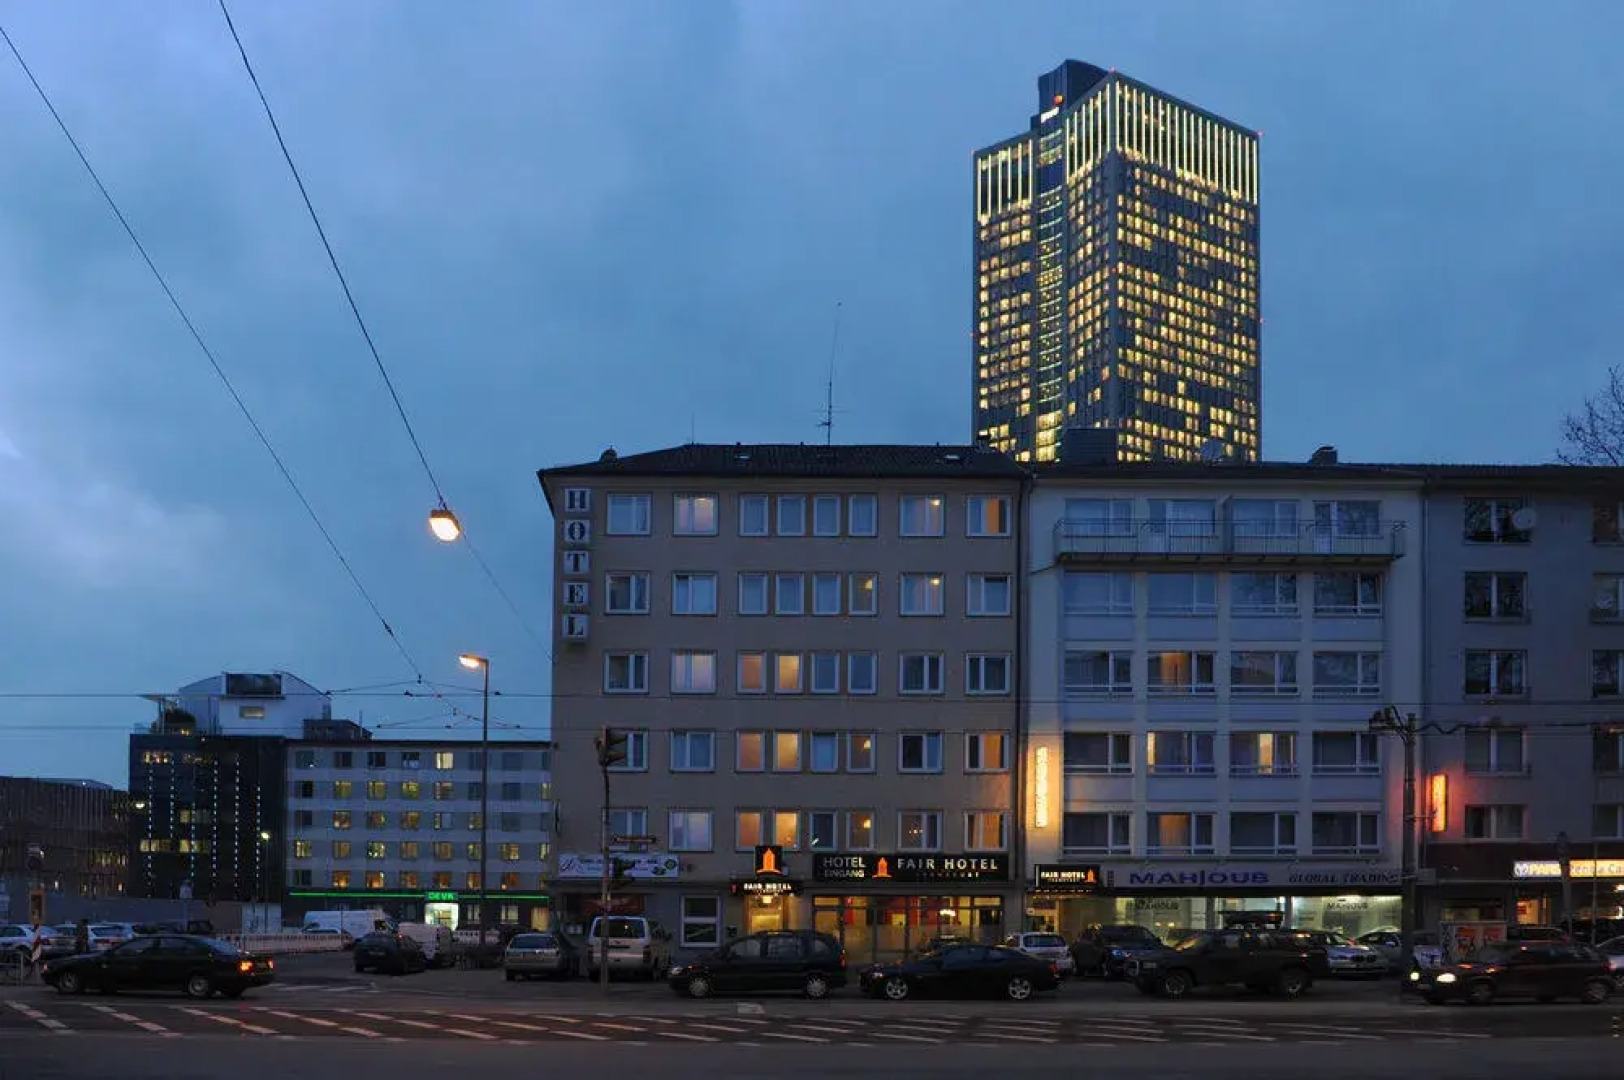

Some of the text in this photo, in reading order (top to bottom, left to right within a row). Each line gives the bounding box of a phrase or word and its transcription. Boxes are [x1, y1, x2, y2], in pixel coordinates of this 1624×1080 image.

[566, 489, 588, 637] HOTEL
[822, 856, 867, 868] HOTEL
[897, 858, 998, 870] FAIR HOTEL
[823, 868, 865, 878] EINGANG
[1040, 871, 1086, 879] FAIR HOTEL
[1129, 870, 1270, 887] MAHJOUB
[743, 883, 792, 891] FAIR HOTEL
